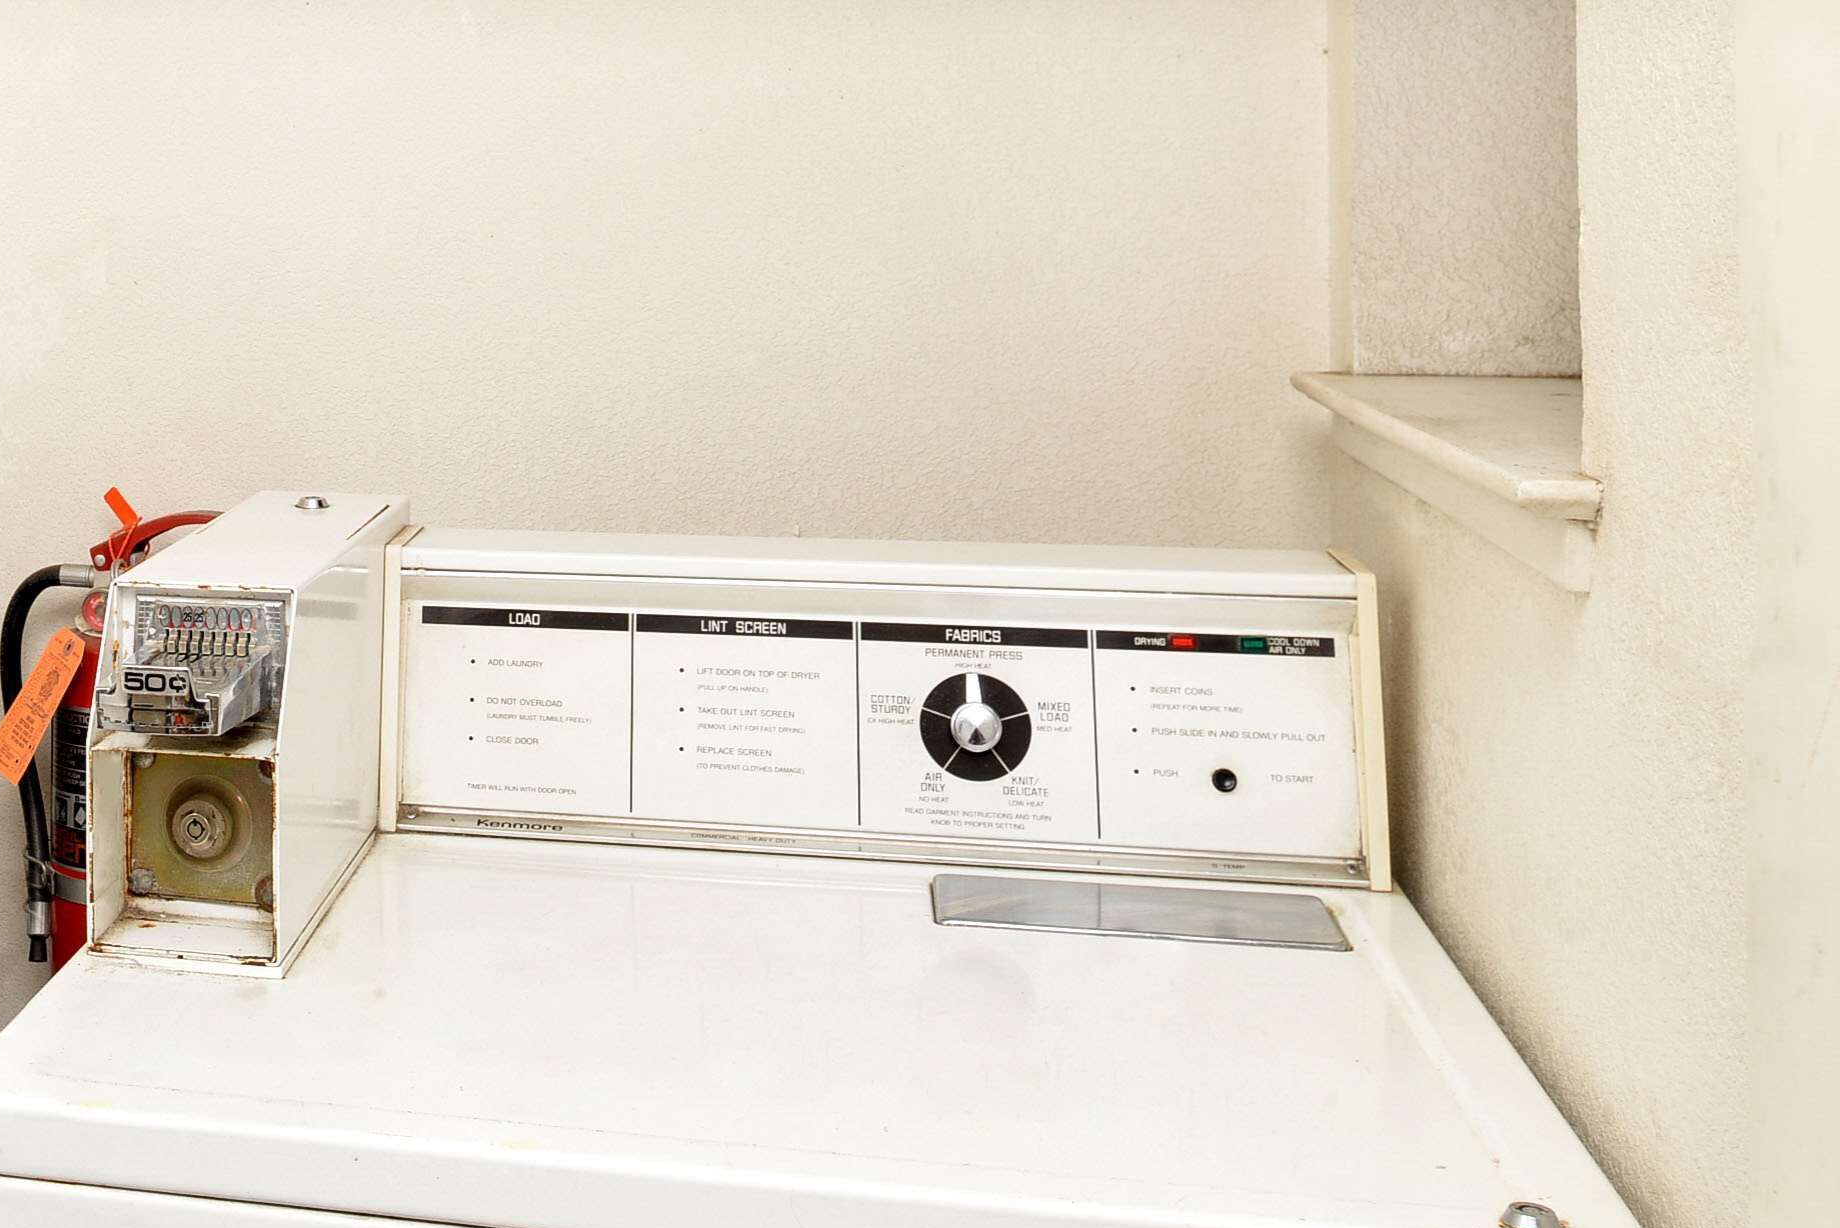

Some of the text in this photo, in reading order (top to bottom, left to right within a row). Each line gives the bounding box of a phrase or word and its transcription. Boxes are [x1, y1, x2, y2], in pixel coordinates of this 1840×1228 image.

[508, 612, 541, 626] LOAD
[700, 619, 787, 635] LINT SCREEN
[945, 628, 1002, 643] FABRICS
[1134, 637, 1166, 647] DRYING
[1268, 637, 1320, 648] COOL DOWN
[1269, 646, 1307, 656] AIR ONLY
[476, 818, 563, 832] Kenmore
